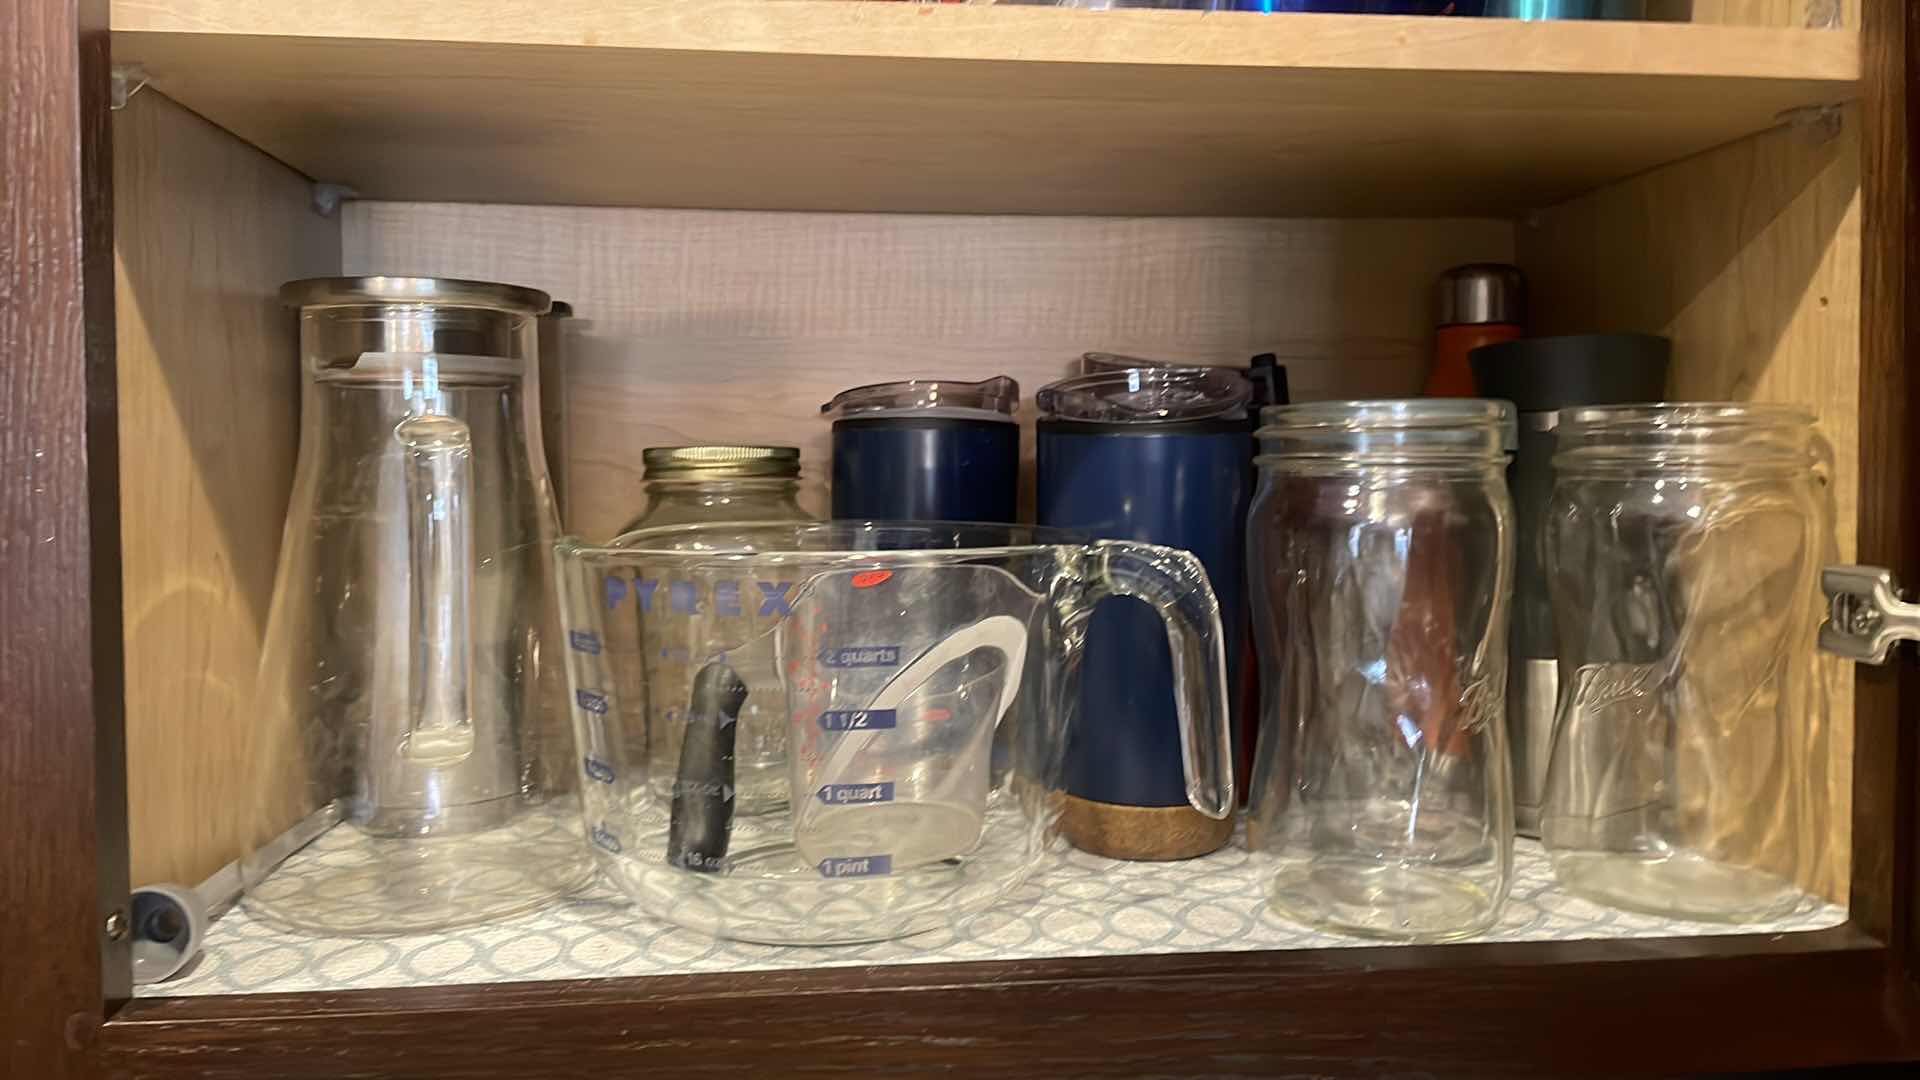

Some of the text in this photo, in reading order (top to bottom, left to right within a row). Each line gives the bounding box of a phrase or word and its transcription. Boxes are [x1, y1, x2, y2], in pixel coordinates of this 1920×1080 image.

[607, 575, 793, 617] PYREX
[840, 648, 898, 666] quarts
[821, 784, 883, 803] 1 quart
[822, 858, 870, 878] 1 pint
